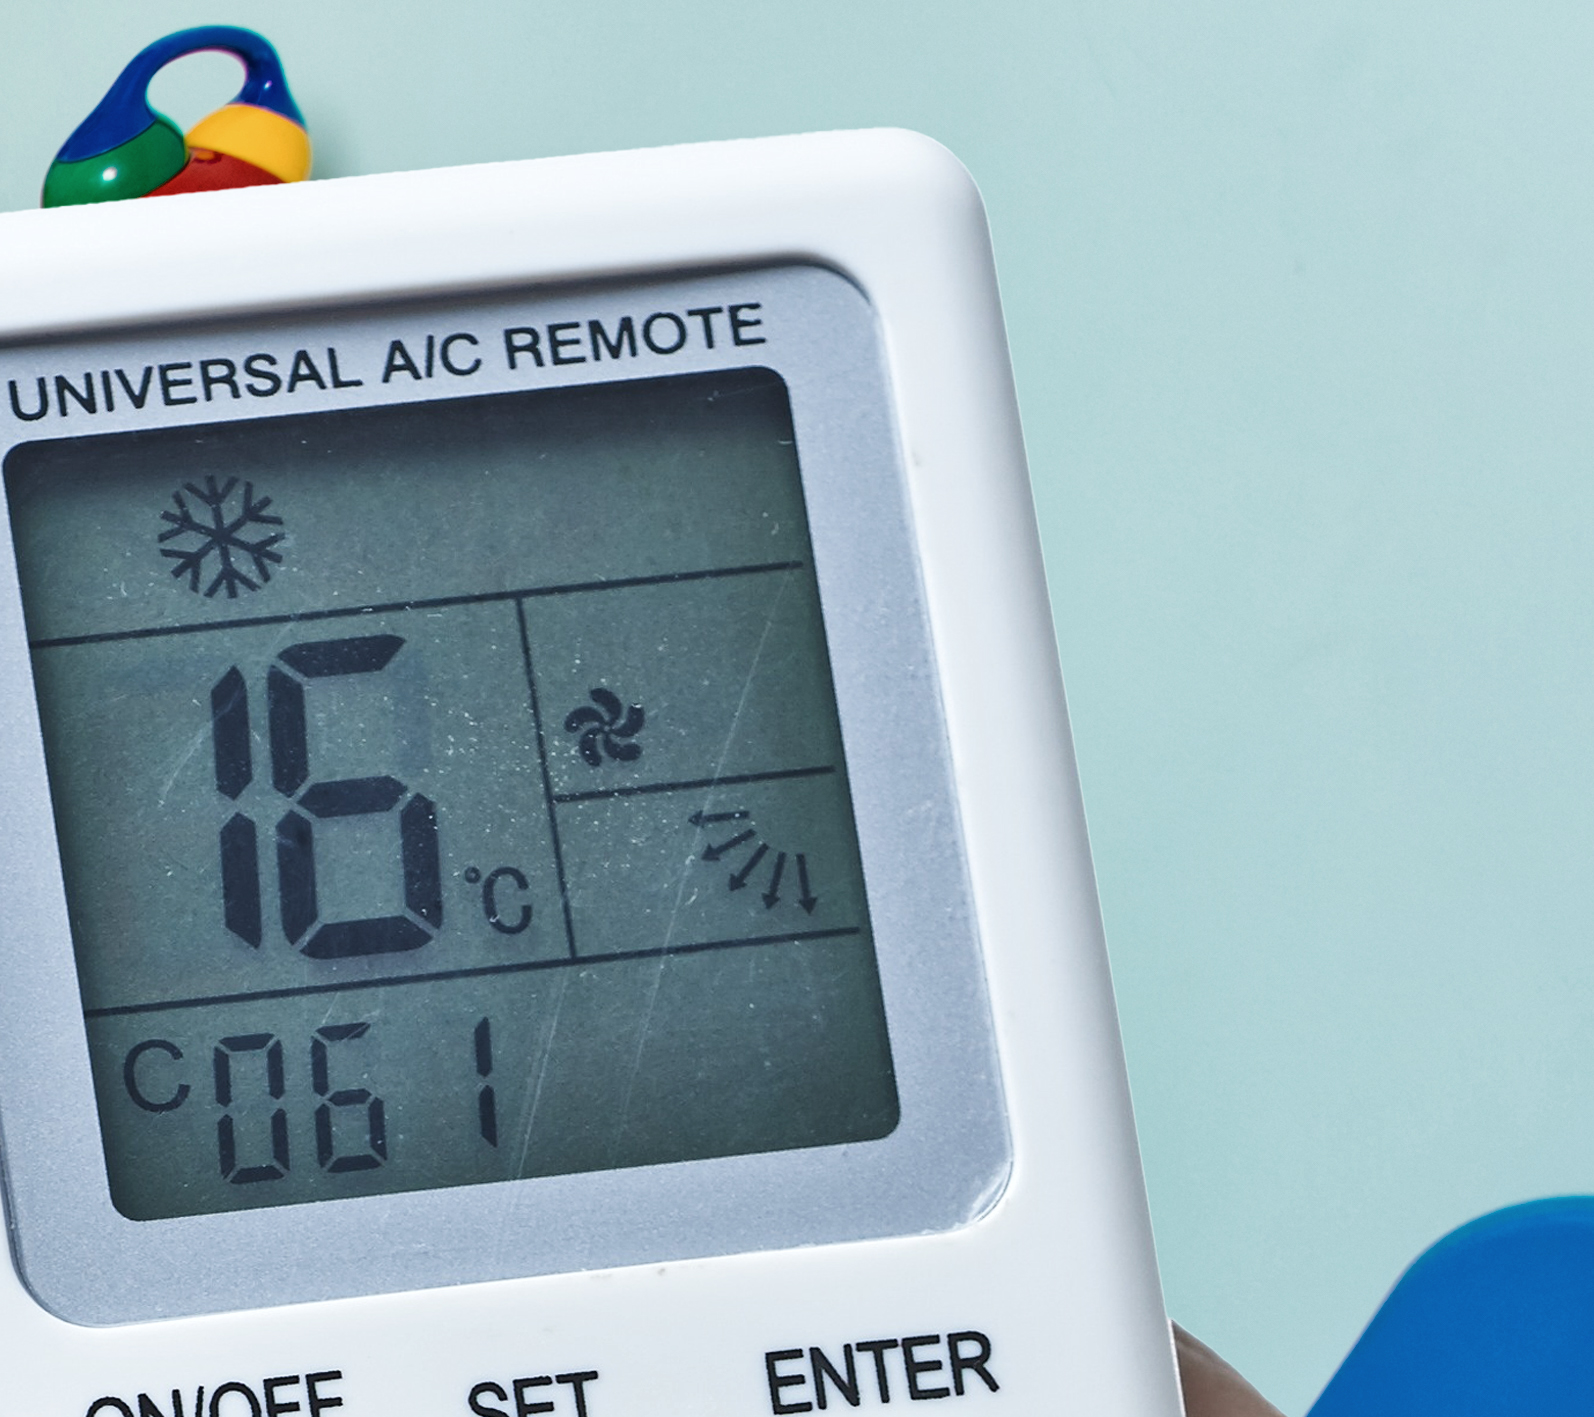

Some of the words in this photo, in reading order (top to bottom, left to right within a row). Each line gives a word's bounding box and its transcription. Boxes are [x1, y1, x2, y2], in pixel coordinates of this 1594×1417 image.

[5, 345, 362, 423] UNIVERSAL
[380, 329, 483, 385] A/C
[504, 303, 768, 371] REMOTE
[210, 633, 444, 960] 16
[765, 1331, 1000, 1416] ENTER
